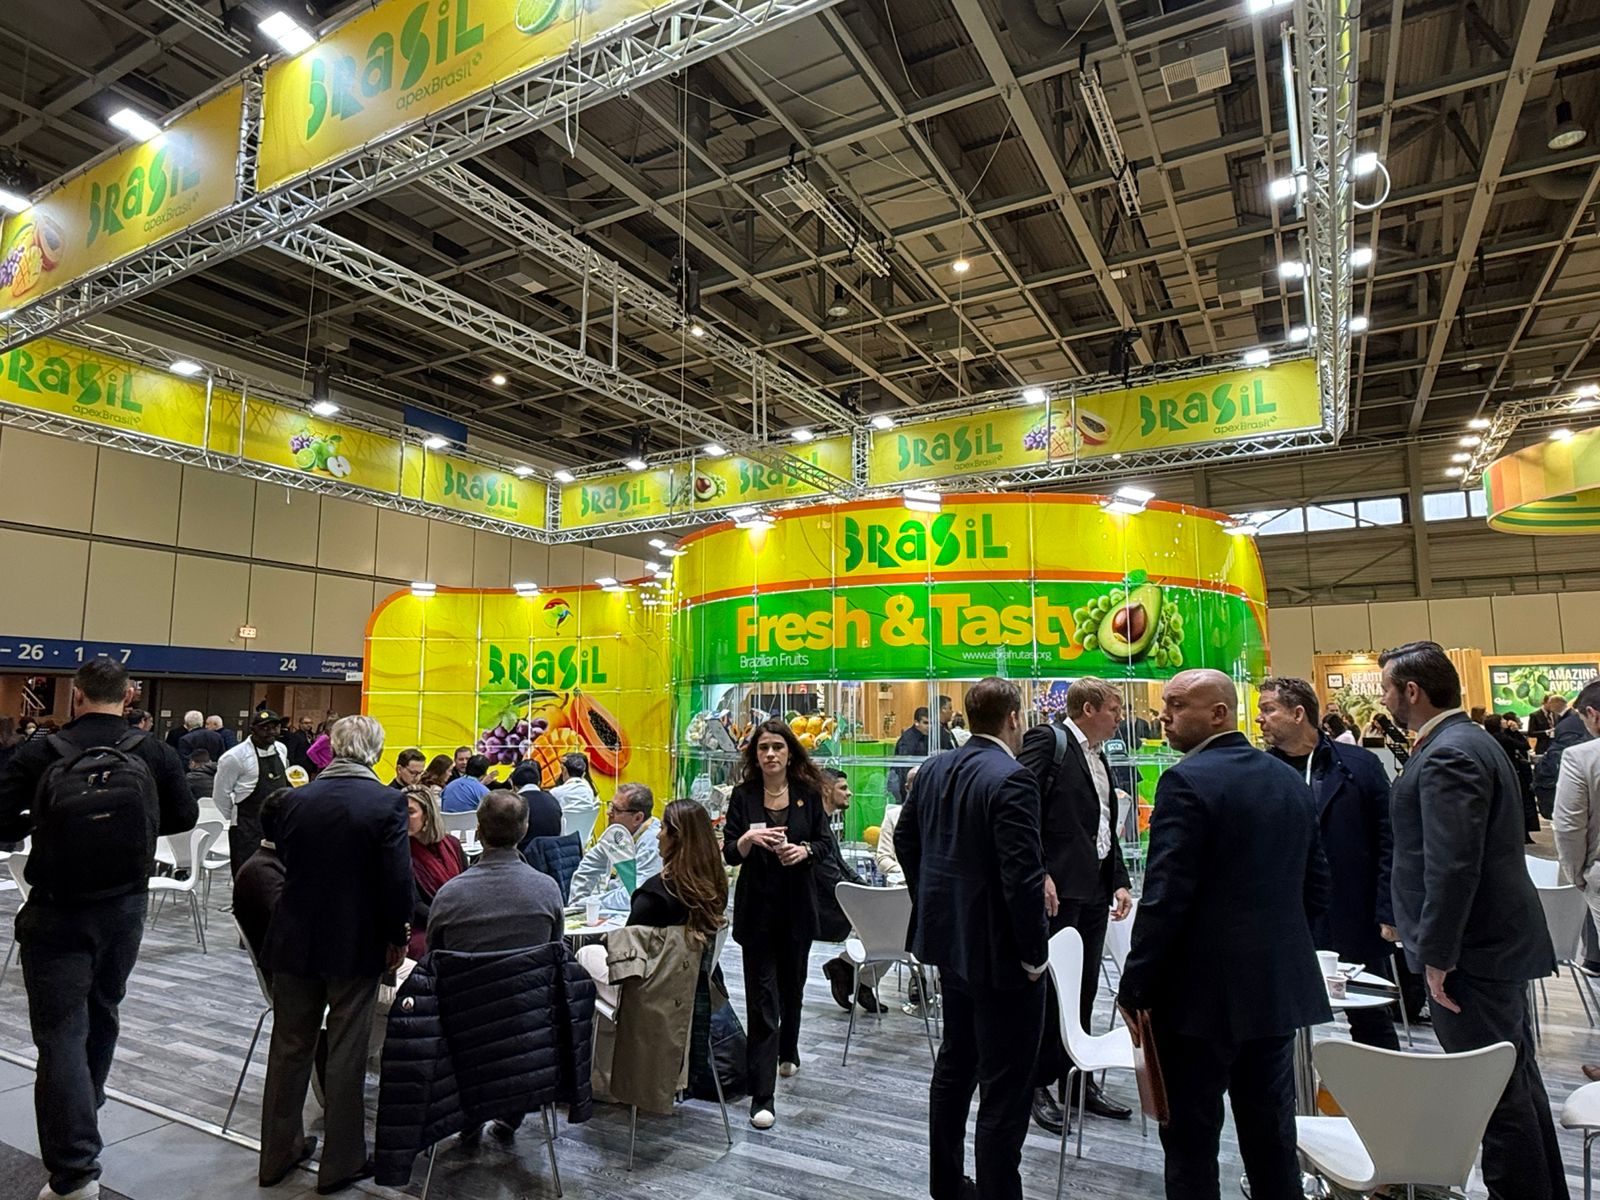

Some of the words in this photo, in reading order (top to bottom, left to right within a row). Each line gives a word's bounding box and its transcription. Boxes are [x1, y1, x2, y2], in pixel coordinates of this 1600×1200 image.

[737, 596, 872, 654] Fresh
[880, 594, 931, 647] &
[930, 592, 1086, 661] Tasty
[18, 643, 44, 661] 26
[74, 646, 84, 662] 1
[120, 649, 131, 664] 7
[740, 654, 778, 669] Brazilian
[779, 653, 809, 667] Fruits
[280, 658, 298, 672] 24
